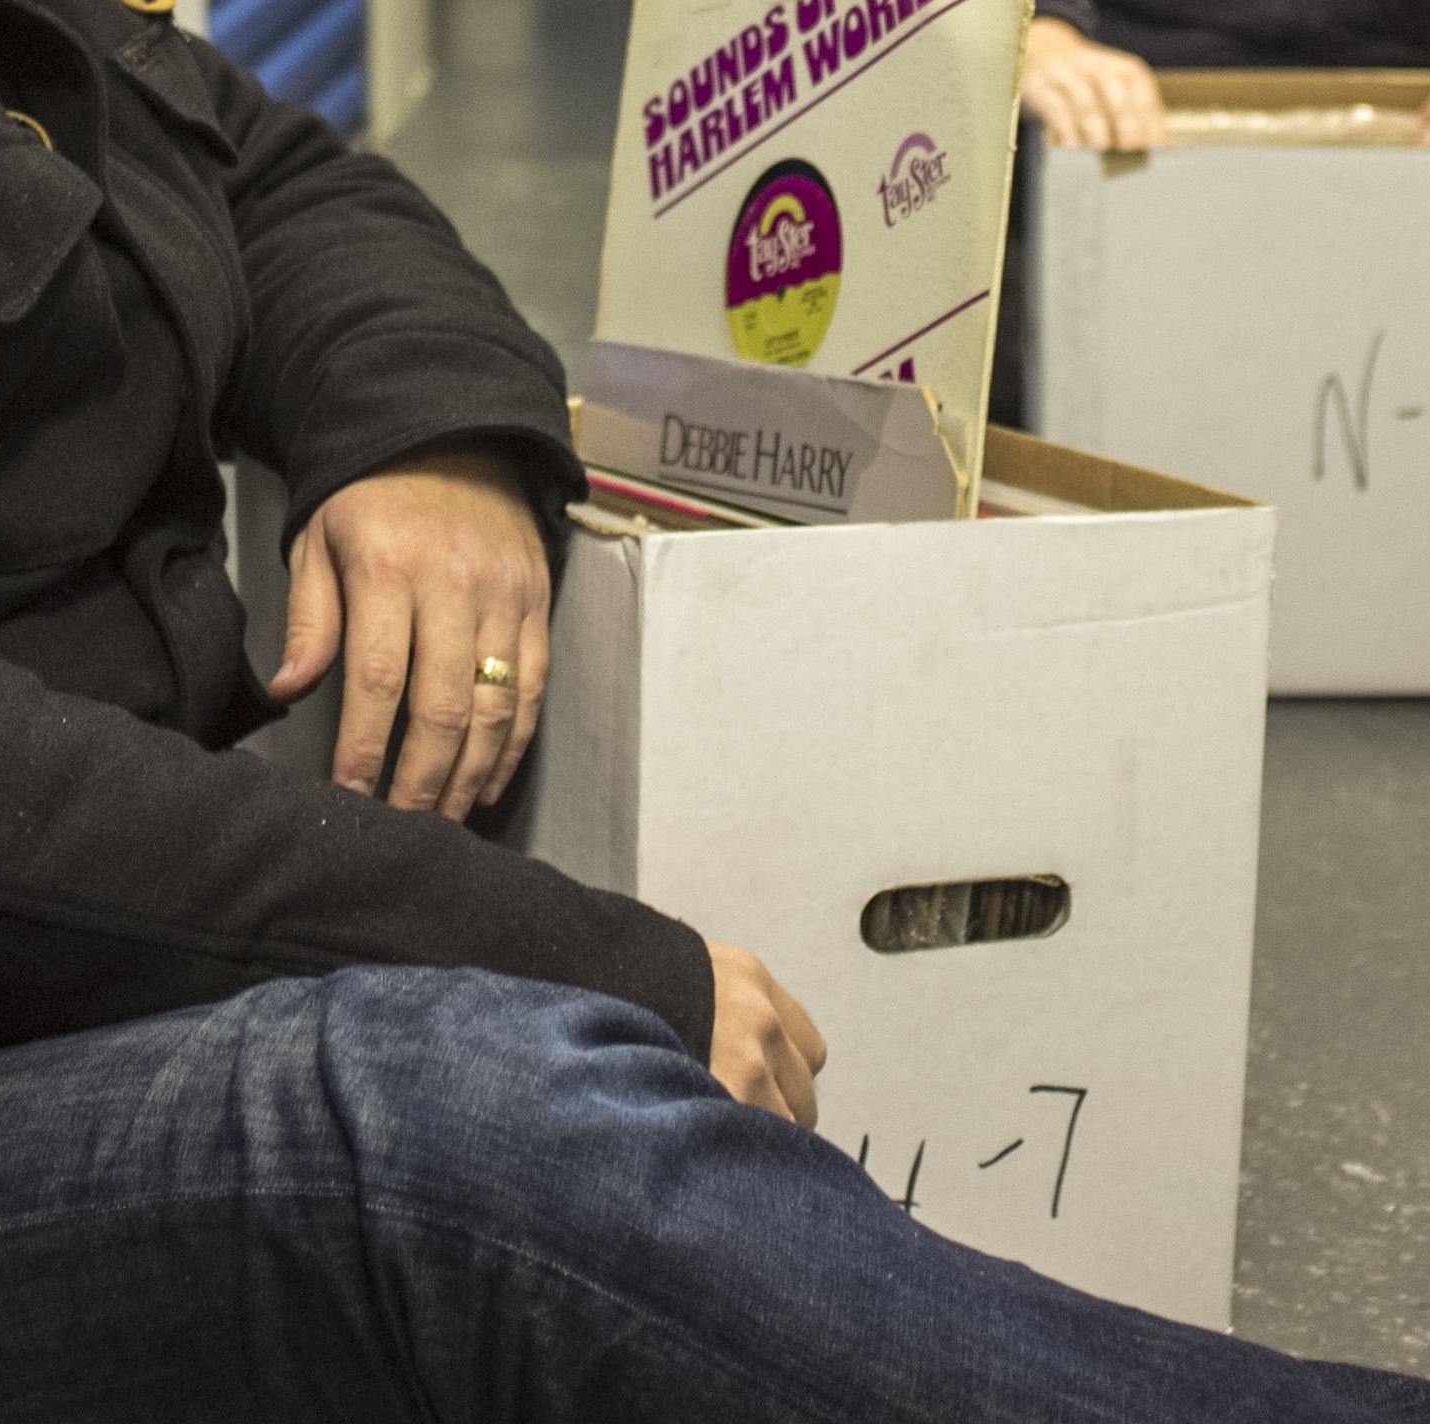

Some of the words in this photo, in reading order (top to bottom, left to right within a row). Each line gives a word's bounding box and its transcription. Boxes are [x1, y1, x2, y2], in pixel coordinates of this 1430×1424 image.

[642, 4, 790, 149] SOUNDS
[648, 52, 797, 202] HARLEM
[658, 412, 750, 480] DEBBIE
[752, 428, 854, 499] HARRY
